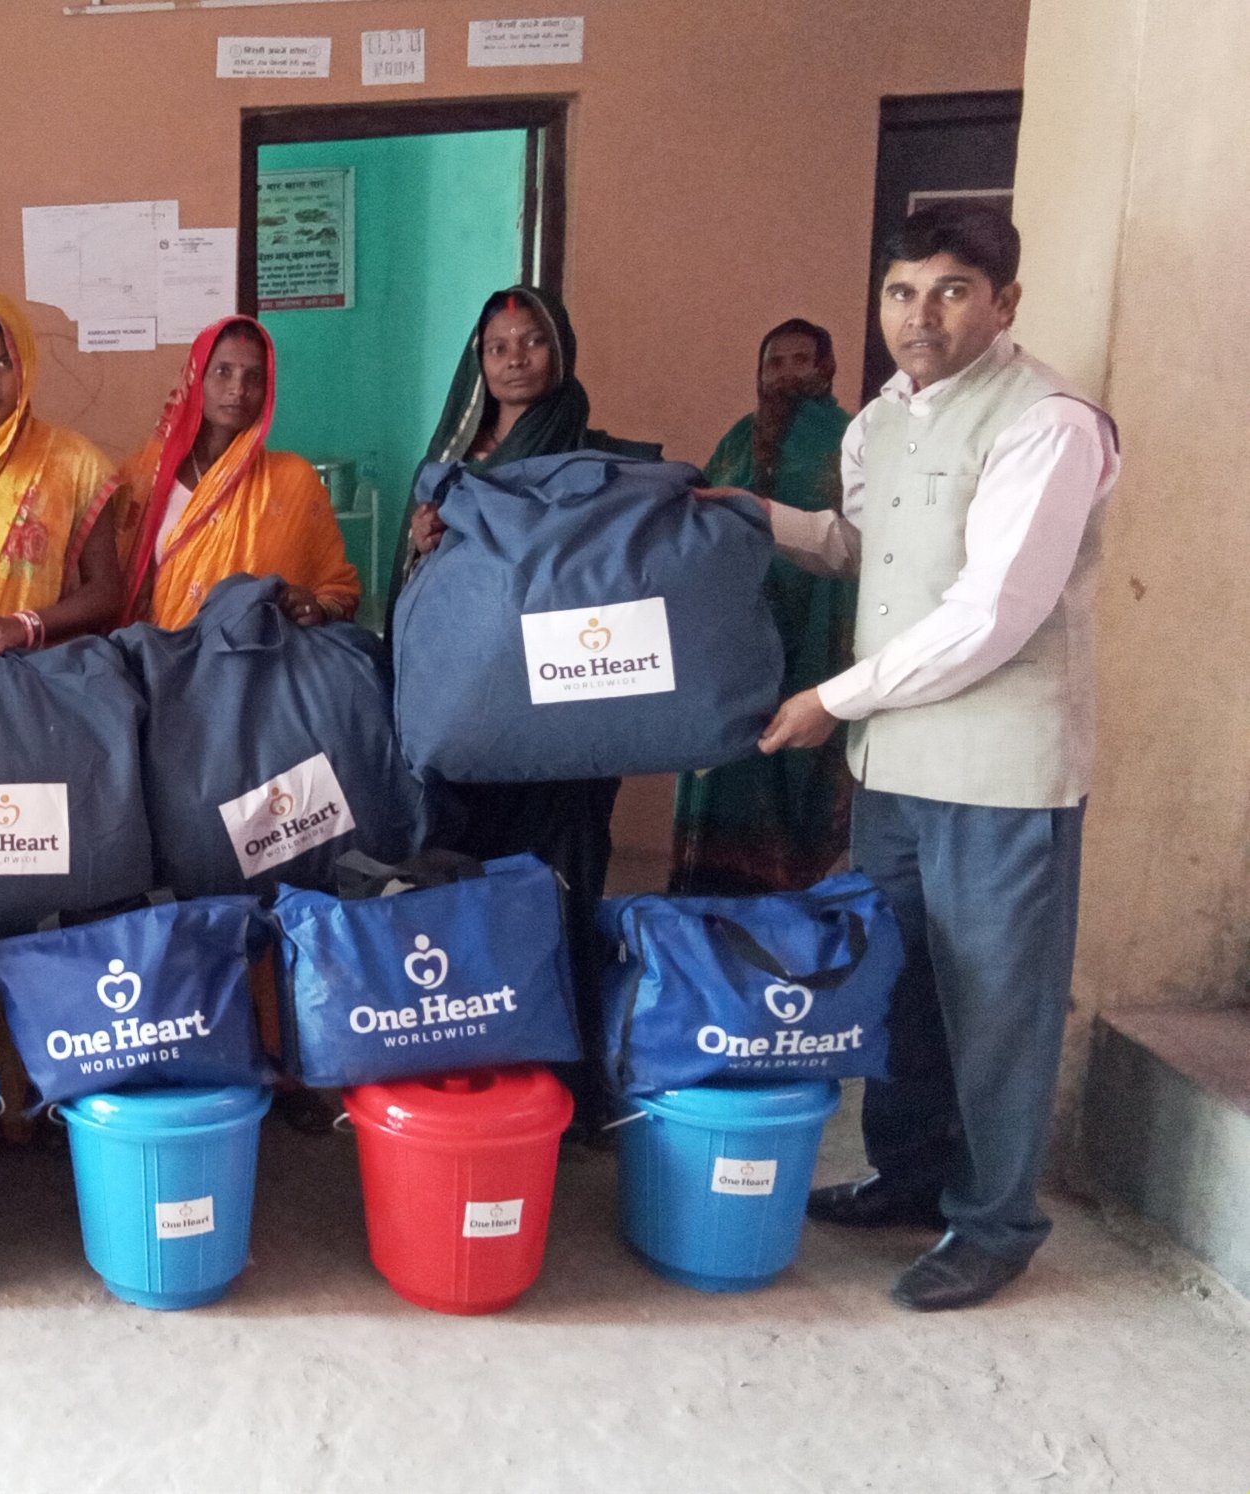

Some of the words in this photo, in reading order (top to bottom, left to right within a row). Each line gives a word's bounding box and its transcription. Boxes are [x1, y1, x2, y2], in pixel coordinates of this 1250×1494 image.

[539, 662, 586, 680] One
[589, 652, 660, 676] Heart
[563, 677, 637, 691] WORLDWIDE
[245, 830, 282, 856] One
[281, 800, 340, 839] Heart
[350, 1005, 418, 1034] One
[419, 984, 518, 1026] Heart
[46, 1029, 111, 1061] One
[111, 1009, 210, 1051] Heart
[384, 1023, 488, 1048] WORLDWIDE
[697, 1024, 770, 1058] One
[771, 1023, 864, 1057] Heart
[79, 1047, 181, 1075] WORLDWIDE
[719, 1176, 740, 1185] One
[741, 1178, 770, 1186] Heart
[161, 1220, 181, 1229] One
[183, 1215, 210, 1228] Heart
[470, 1220, 490, 1228] One
[492, 1218, 517, 1228] Heart
